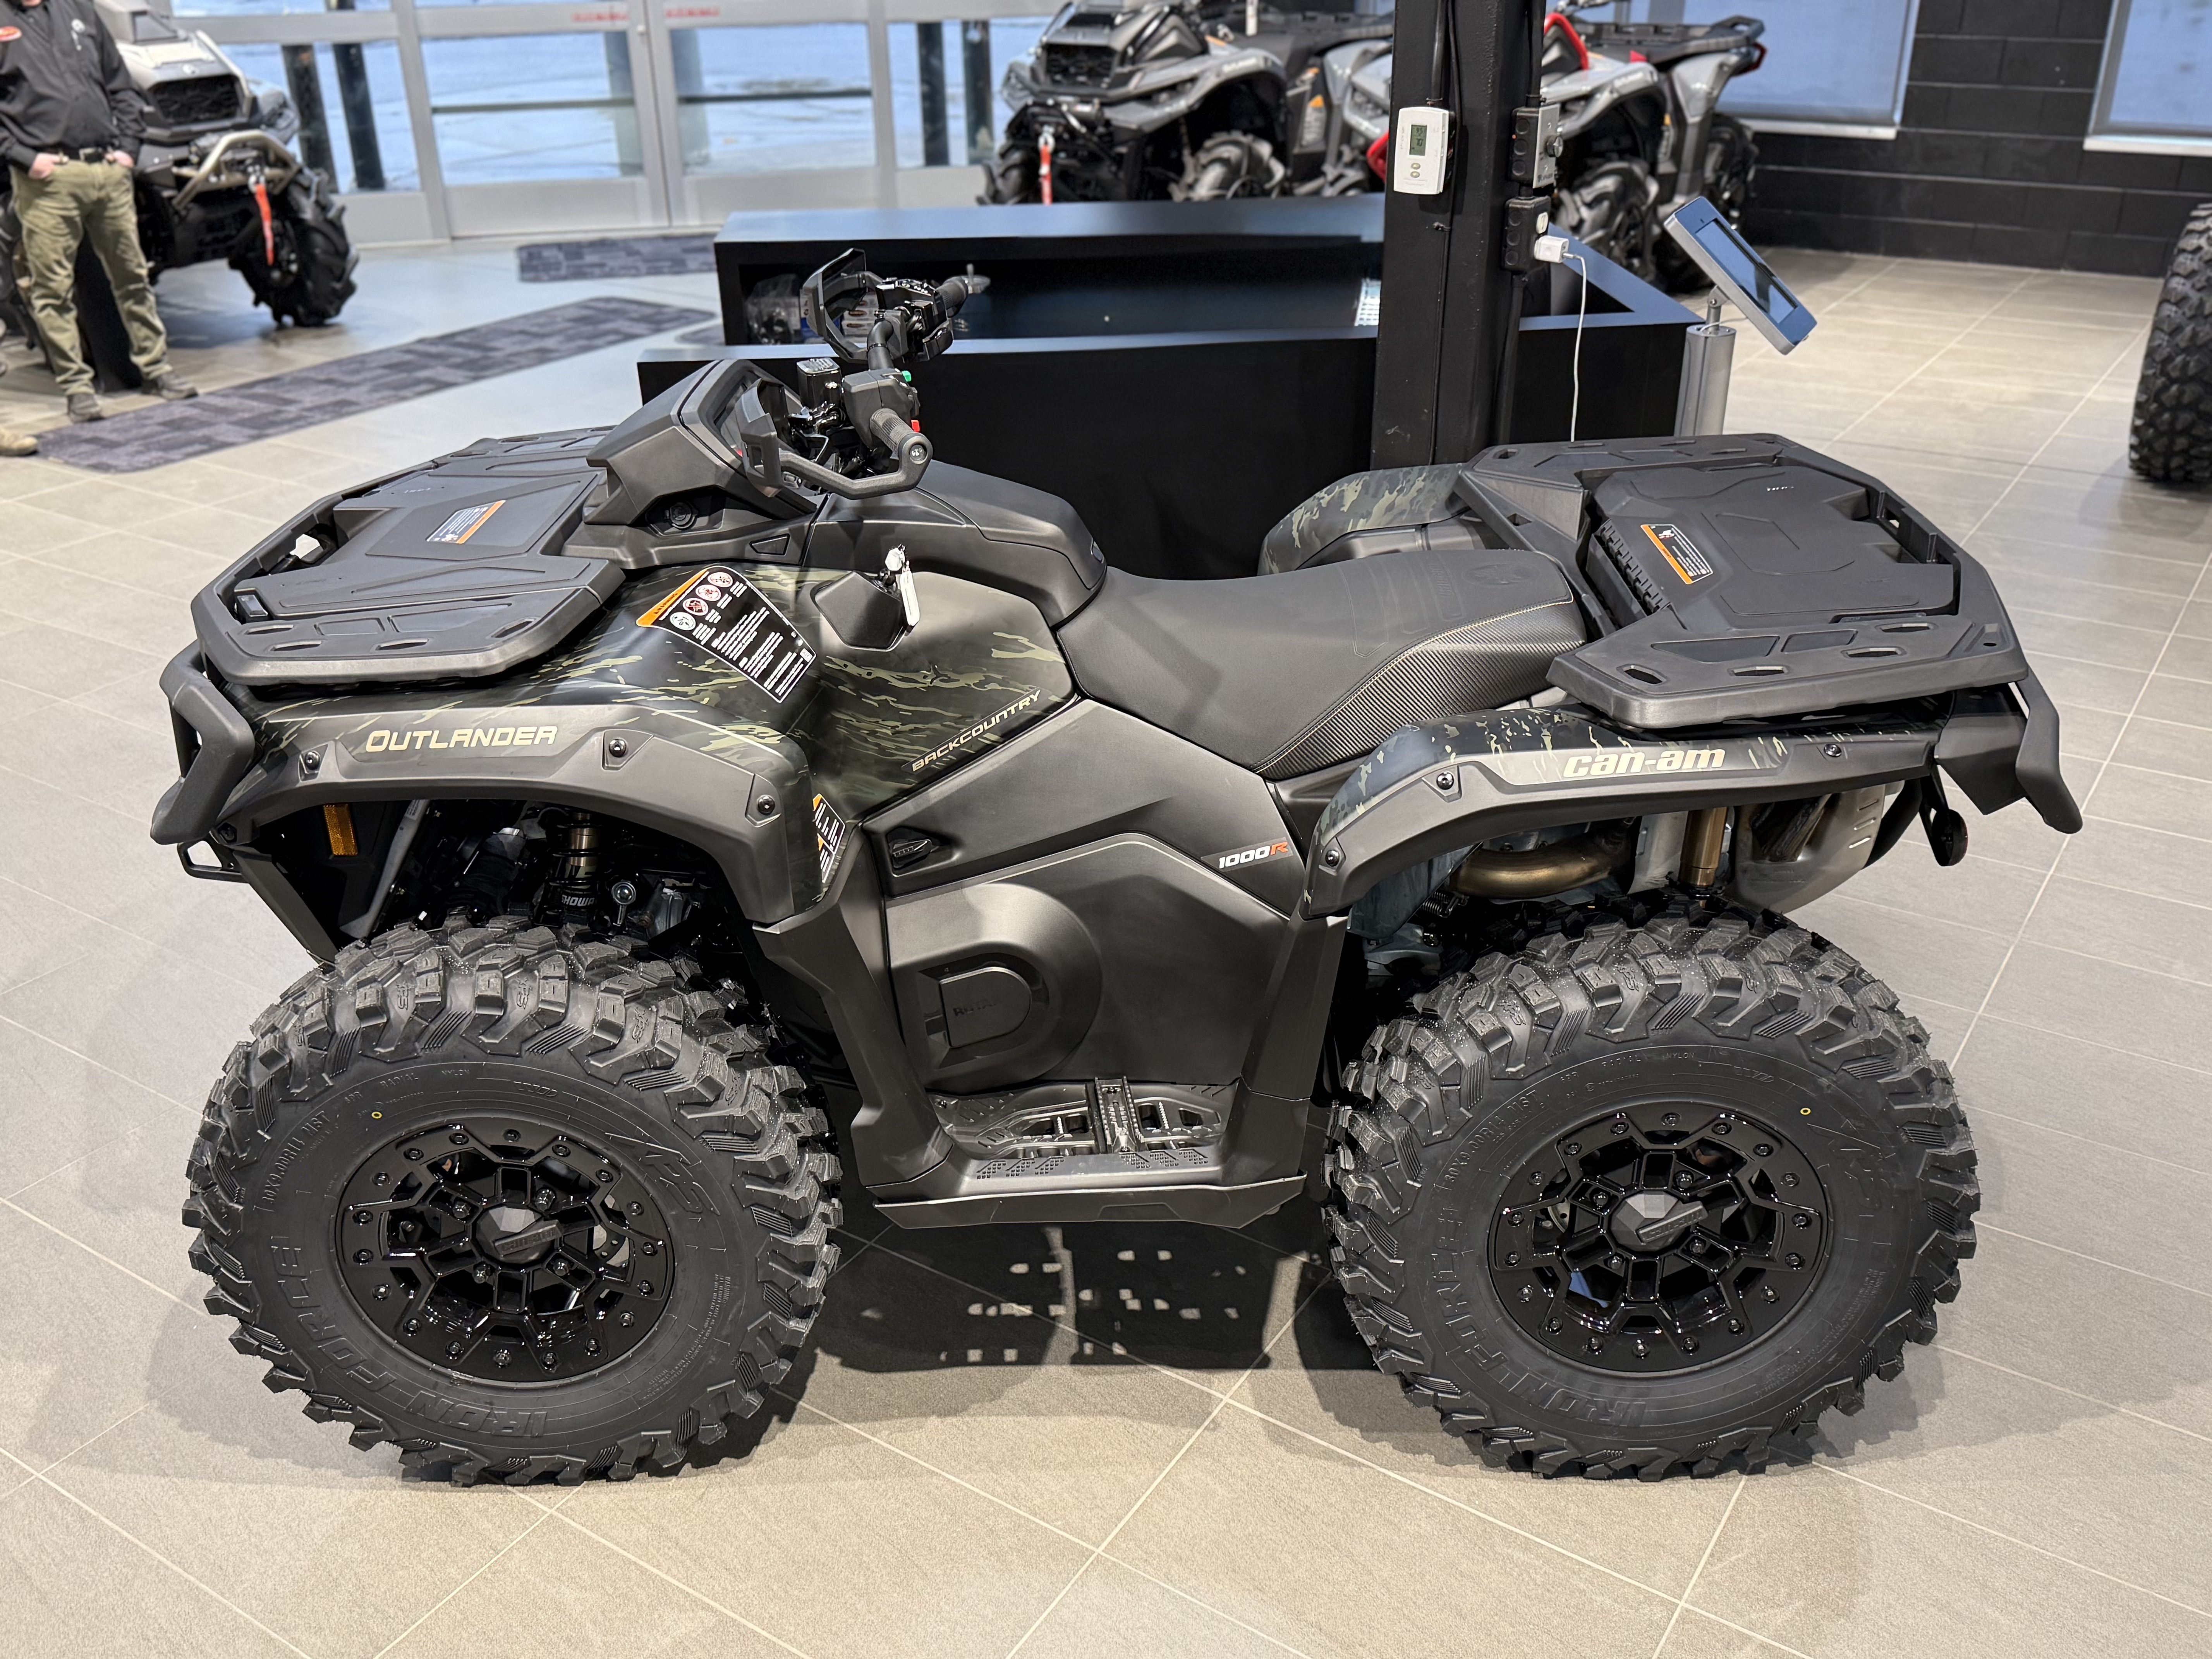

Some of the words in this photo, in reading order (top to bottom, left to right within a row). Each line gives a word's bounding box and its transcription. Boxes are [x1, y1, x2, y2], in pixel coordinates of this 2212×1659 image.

[365, 725, 558, 752] OUTLANDER
[912, 689, 1041, 772] BACKCOUNTRY
[1563, 749, 1725, 778] can-am
[1219, 841, 1289, 869] 1000R
[404, 1390, 548, 1437] IRON
